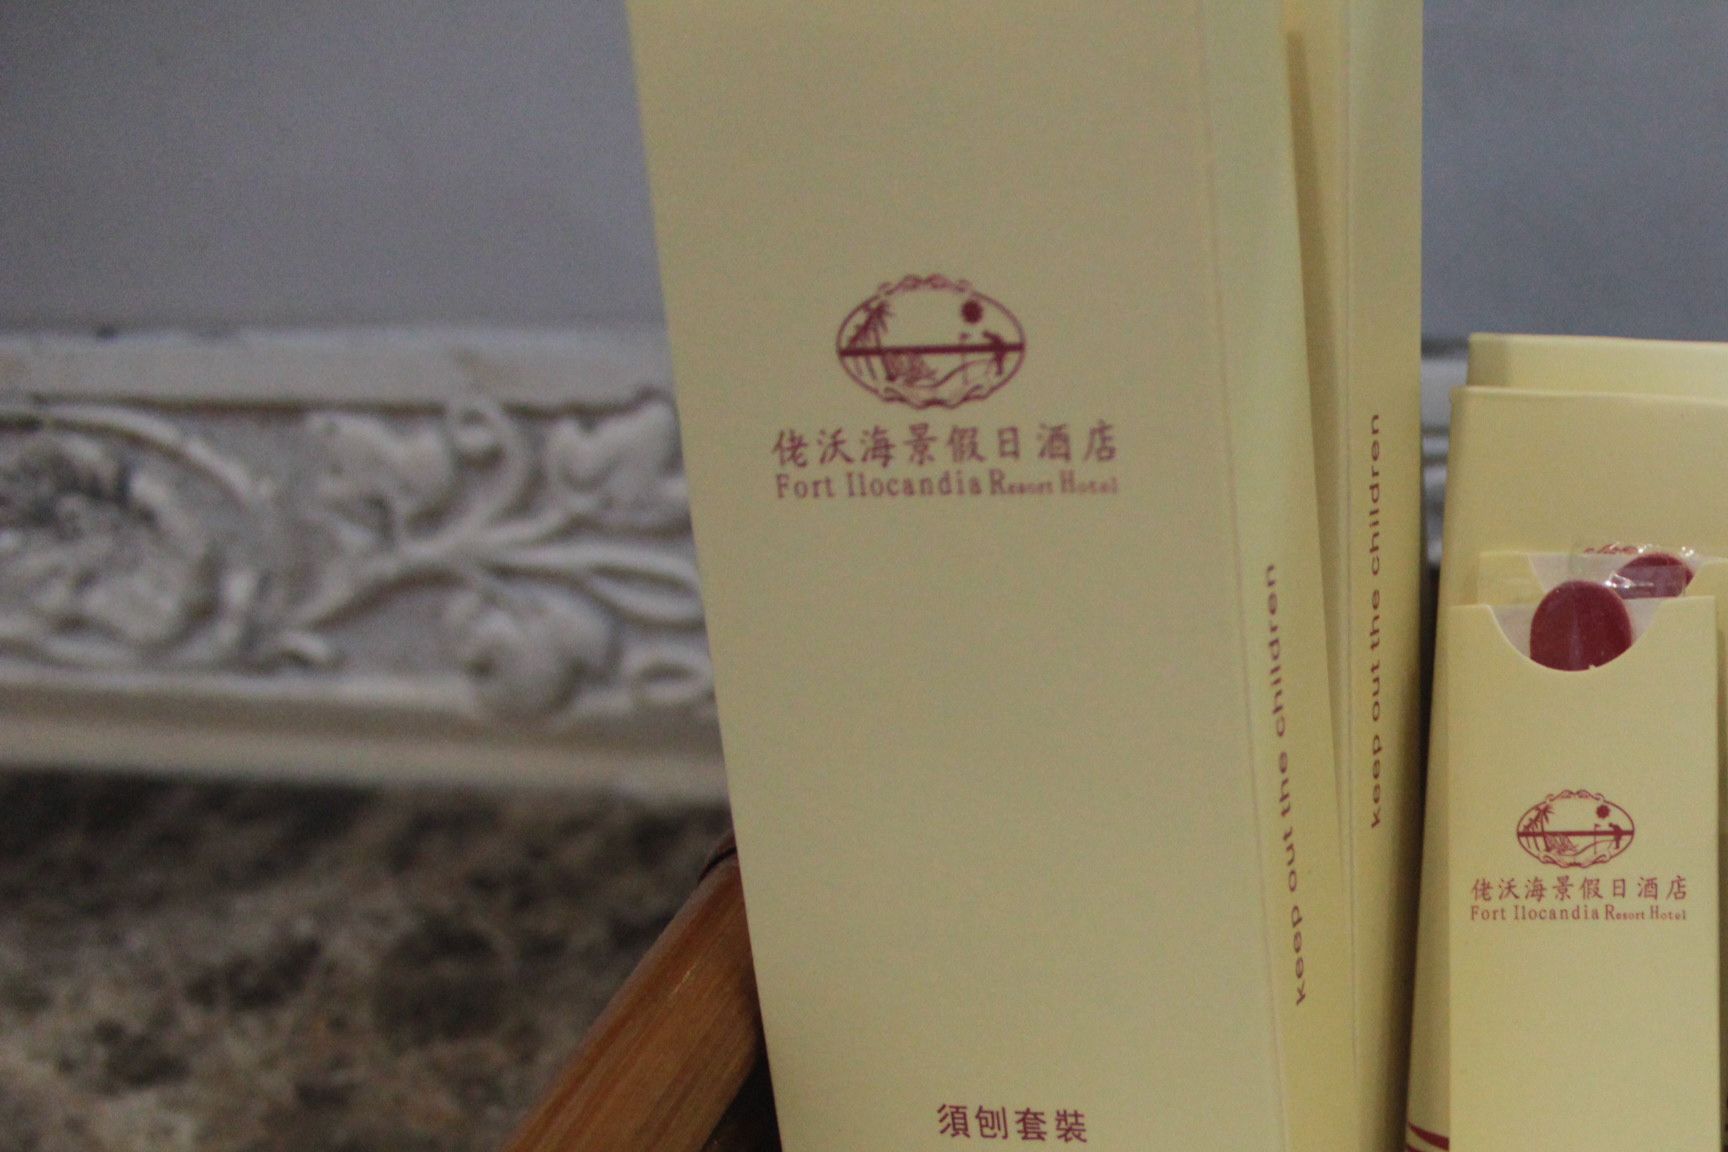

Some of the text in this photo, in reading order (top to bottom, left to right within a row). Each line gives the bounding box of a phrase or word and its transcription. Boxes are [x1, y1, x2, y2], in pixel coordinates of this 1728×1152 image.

[771, 419, 1117, 468] 佬沃海景假日酒店
[774, 467, 1120, 499] Fort Ilocandia Resort Hotel
[1369, 414, 1382, 828] keep out the children
[1266, 564, 1306, 1006] keep out the children
[1471, 875, 1687, 902] 佬沃海景假日酒店
[1470, 903, 1687, 921] Fort Ilocandia Resort Hotel
